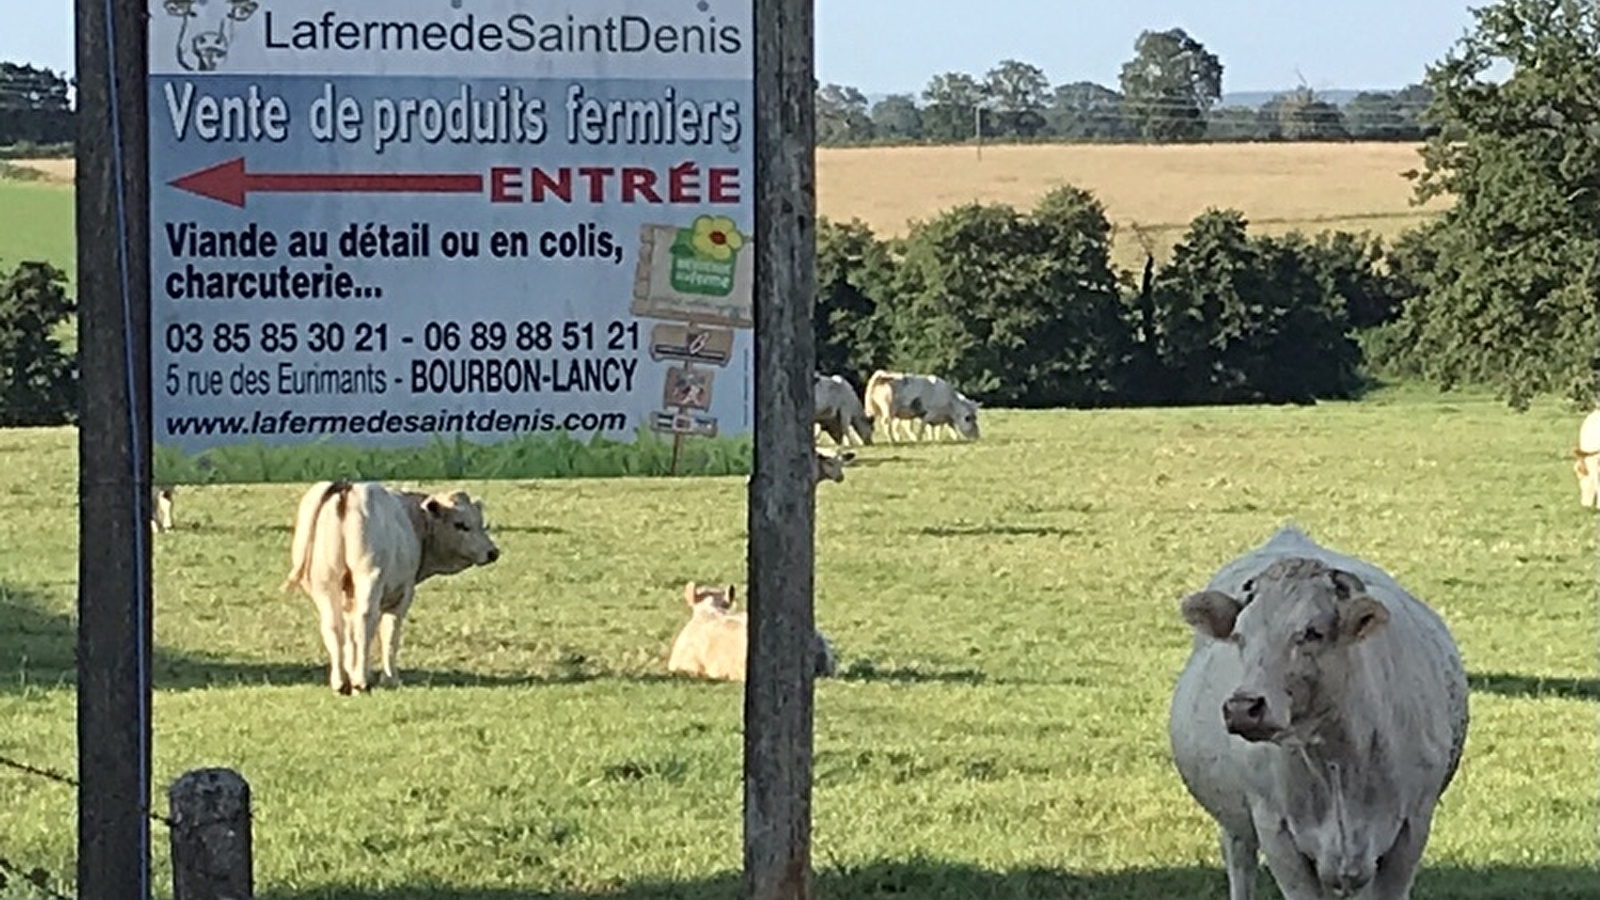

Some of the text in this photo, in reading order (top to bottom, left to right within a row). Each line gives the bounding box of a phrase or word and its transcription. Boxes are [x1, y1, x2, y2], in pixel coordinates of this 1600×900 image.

[265, 11, 742, 53] LafermedeSaintDenis
[164, 82, 741, 154] Vente de produits fermiers
[490, 161, 741, 203] ENTRÉE
[166, 221, 623, 264] Viande au détail ou en colis,
[165, 263, 383, 300] charcuterie...
[166, 321, 639, 353] 03 85 85 30 21 - 06 89 88 51 21
[166, 363, 180, 396] 5
[187, 369, 223, 396] rue
[230, 364, 271, 396] des
[411, 358, 638, 394] BOURBON-LANCY
[166, 408, 627, 435] www.lafermedesaintdenis.com
